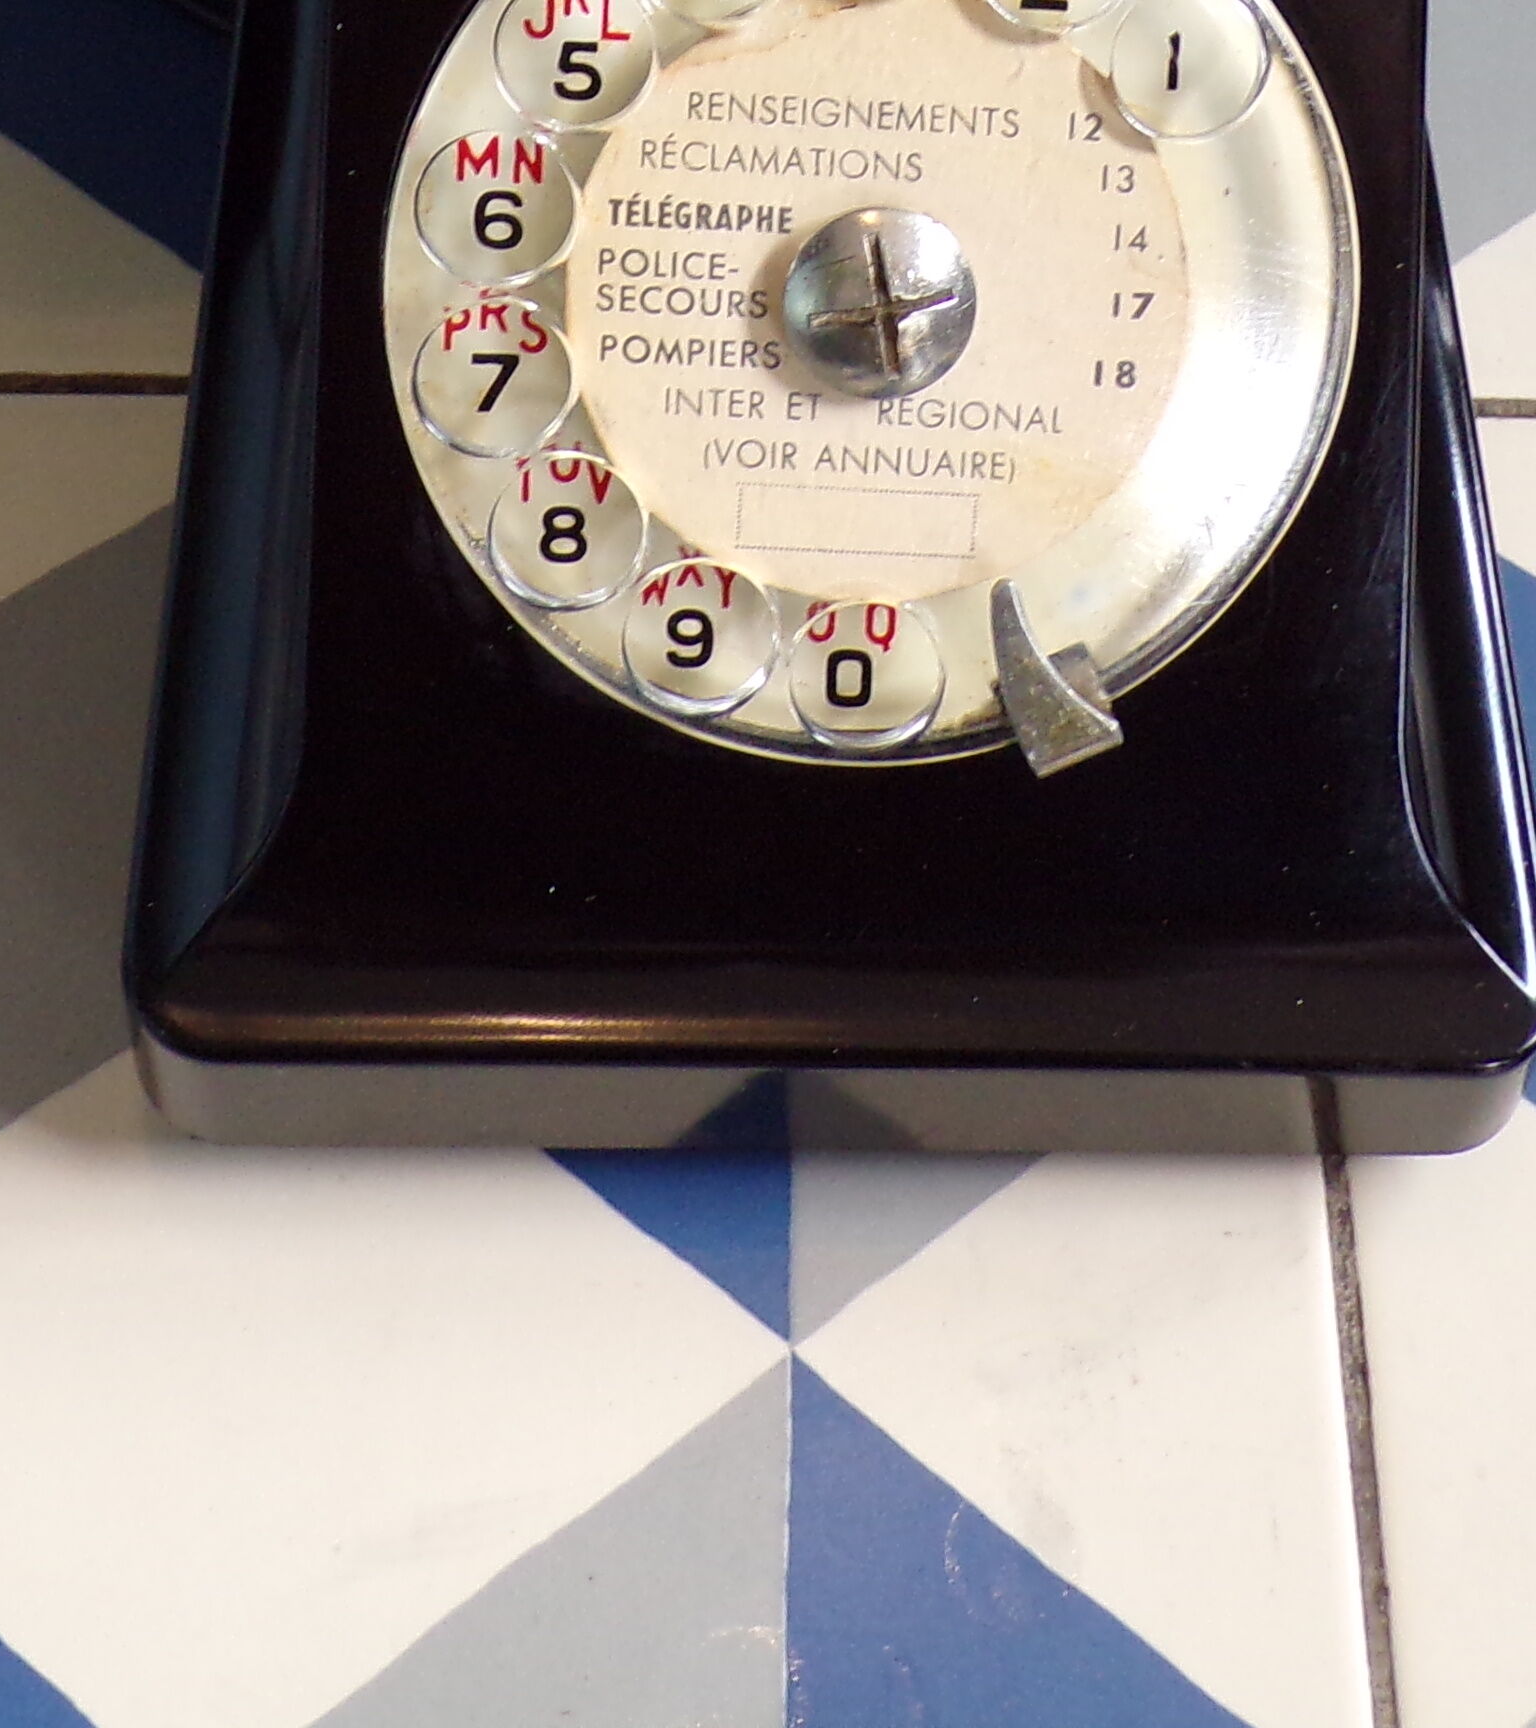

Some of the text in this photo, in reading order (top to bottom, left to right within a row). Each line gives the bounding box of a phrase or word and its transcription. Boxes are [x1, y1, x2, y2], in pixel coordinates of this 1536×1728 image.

[554, 41, 602, 101] 5
[1166, 31, 1181, 90] 1
[687, 91, 1103, 142] RENSEIGNEMENTS 12
[456, 136, 543, 184] MN
[640, 133, 1135, 194] RÉCLAMATIONS 13
[474, 190, 523, 250] 6
[608, 193, 1148, 252] TÉLÉGRAPHE 14
[598, 248, 739, 281] POLICE-
[443, 304, 548, 354] PRS
[596, 283, 1155, 320] SECOURS 17
[471, 353, 520, 412] 7
[600, 334, 1137, 389] POMPIERS 18
[664, 386, 764, 419] INTER
[786, 391, 821, 421] ET
[703, 438, 1016, 481] (VOIR ANNUAIRE)
[540, 506, 587, 562] 8
[666, 609, 714, 668] 9
[826, 649, 872, 708] 0
